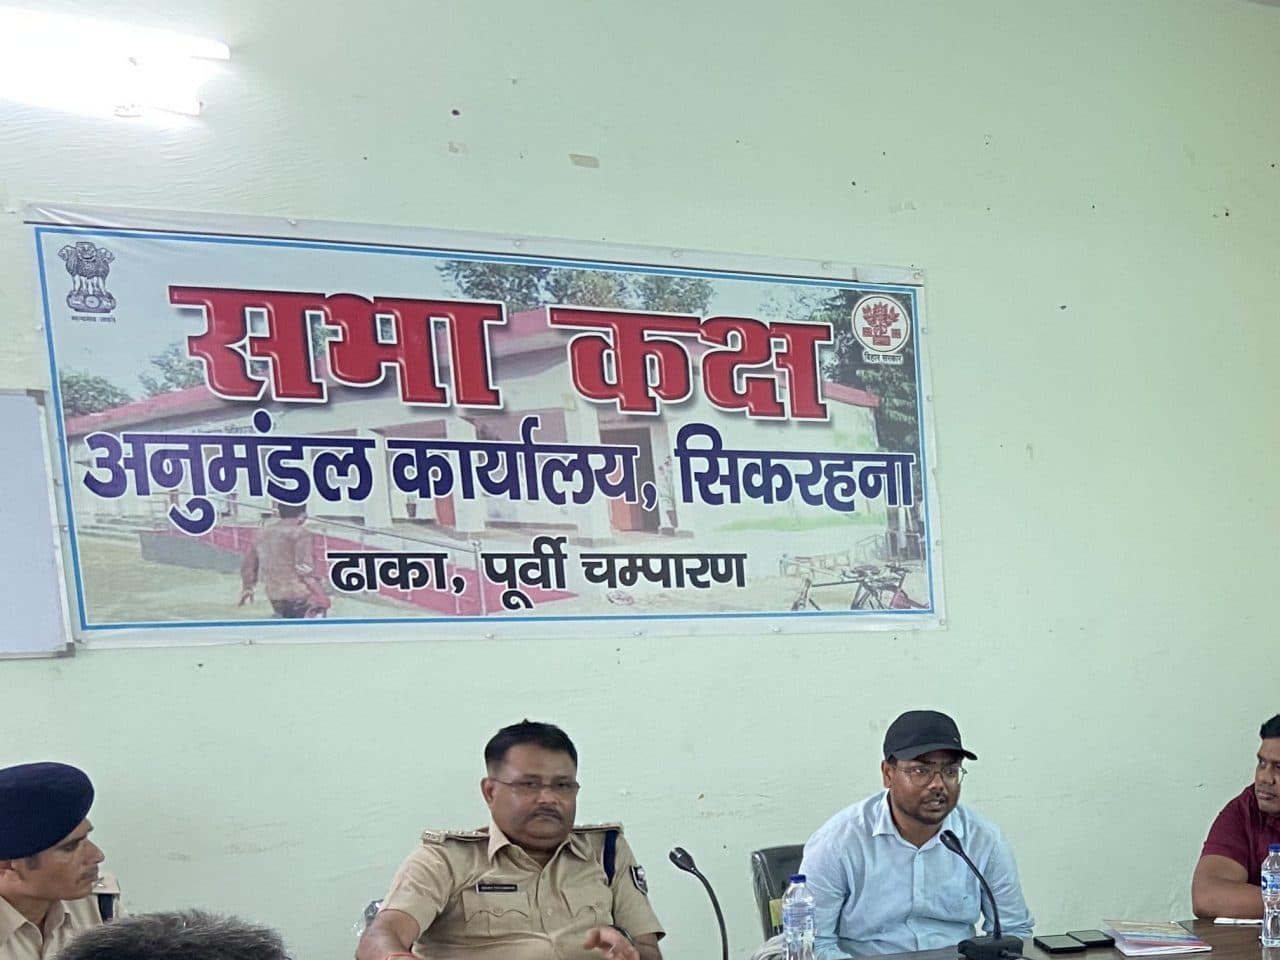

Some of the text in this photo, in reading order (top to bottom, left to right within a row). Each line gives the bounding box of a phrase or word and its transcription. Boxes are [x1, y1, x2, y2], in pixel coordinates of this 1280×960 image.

[168, 285, 832, 420] सभा कक्ष
[83, 410, 914, 535] अनुमंडल कार्यालय, सिकरहना
[326, 536, 747, 609] ढाका, पूर्वी चम्पारण
